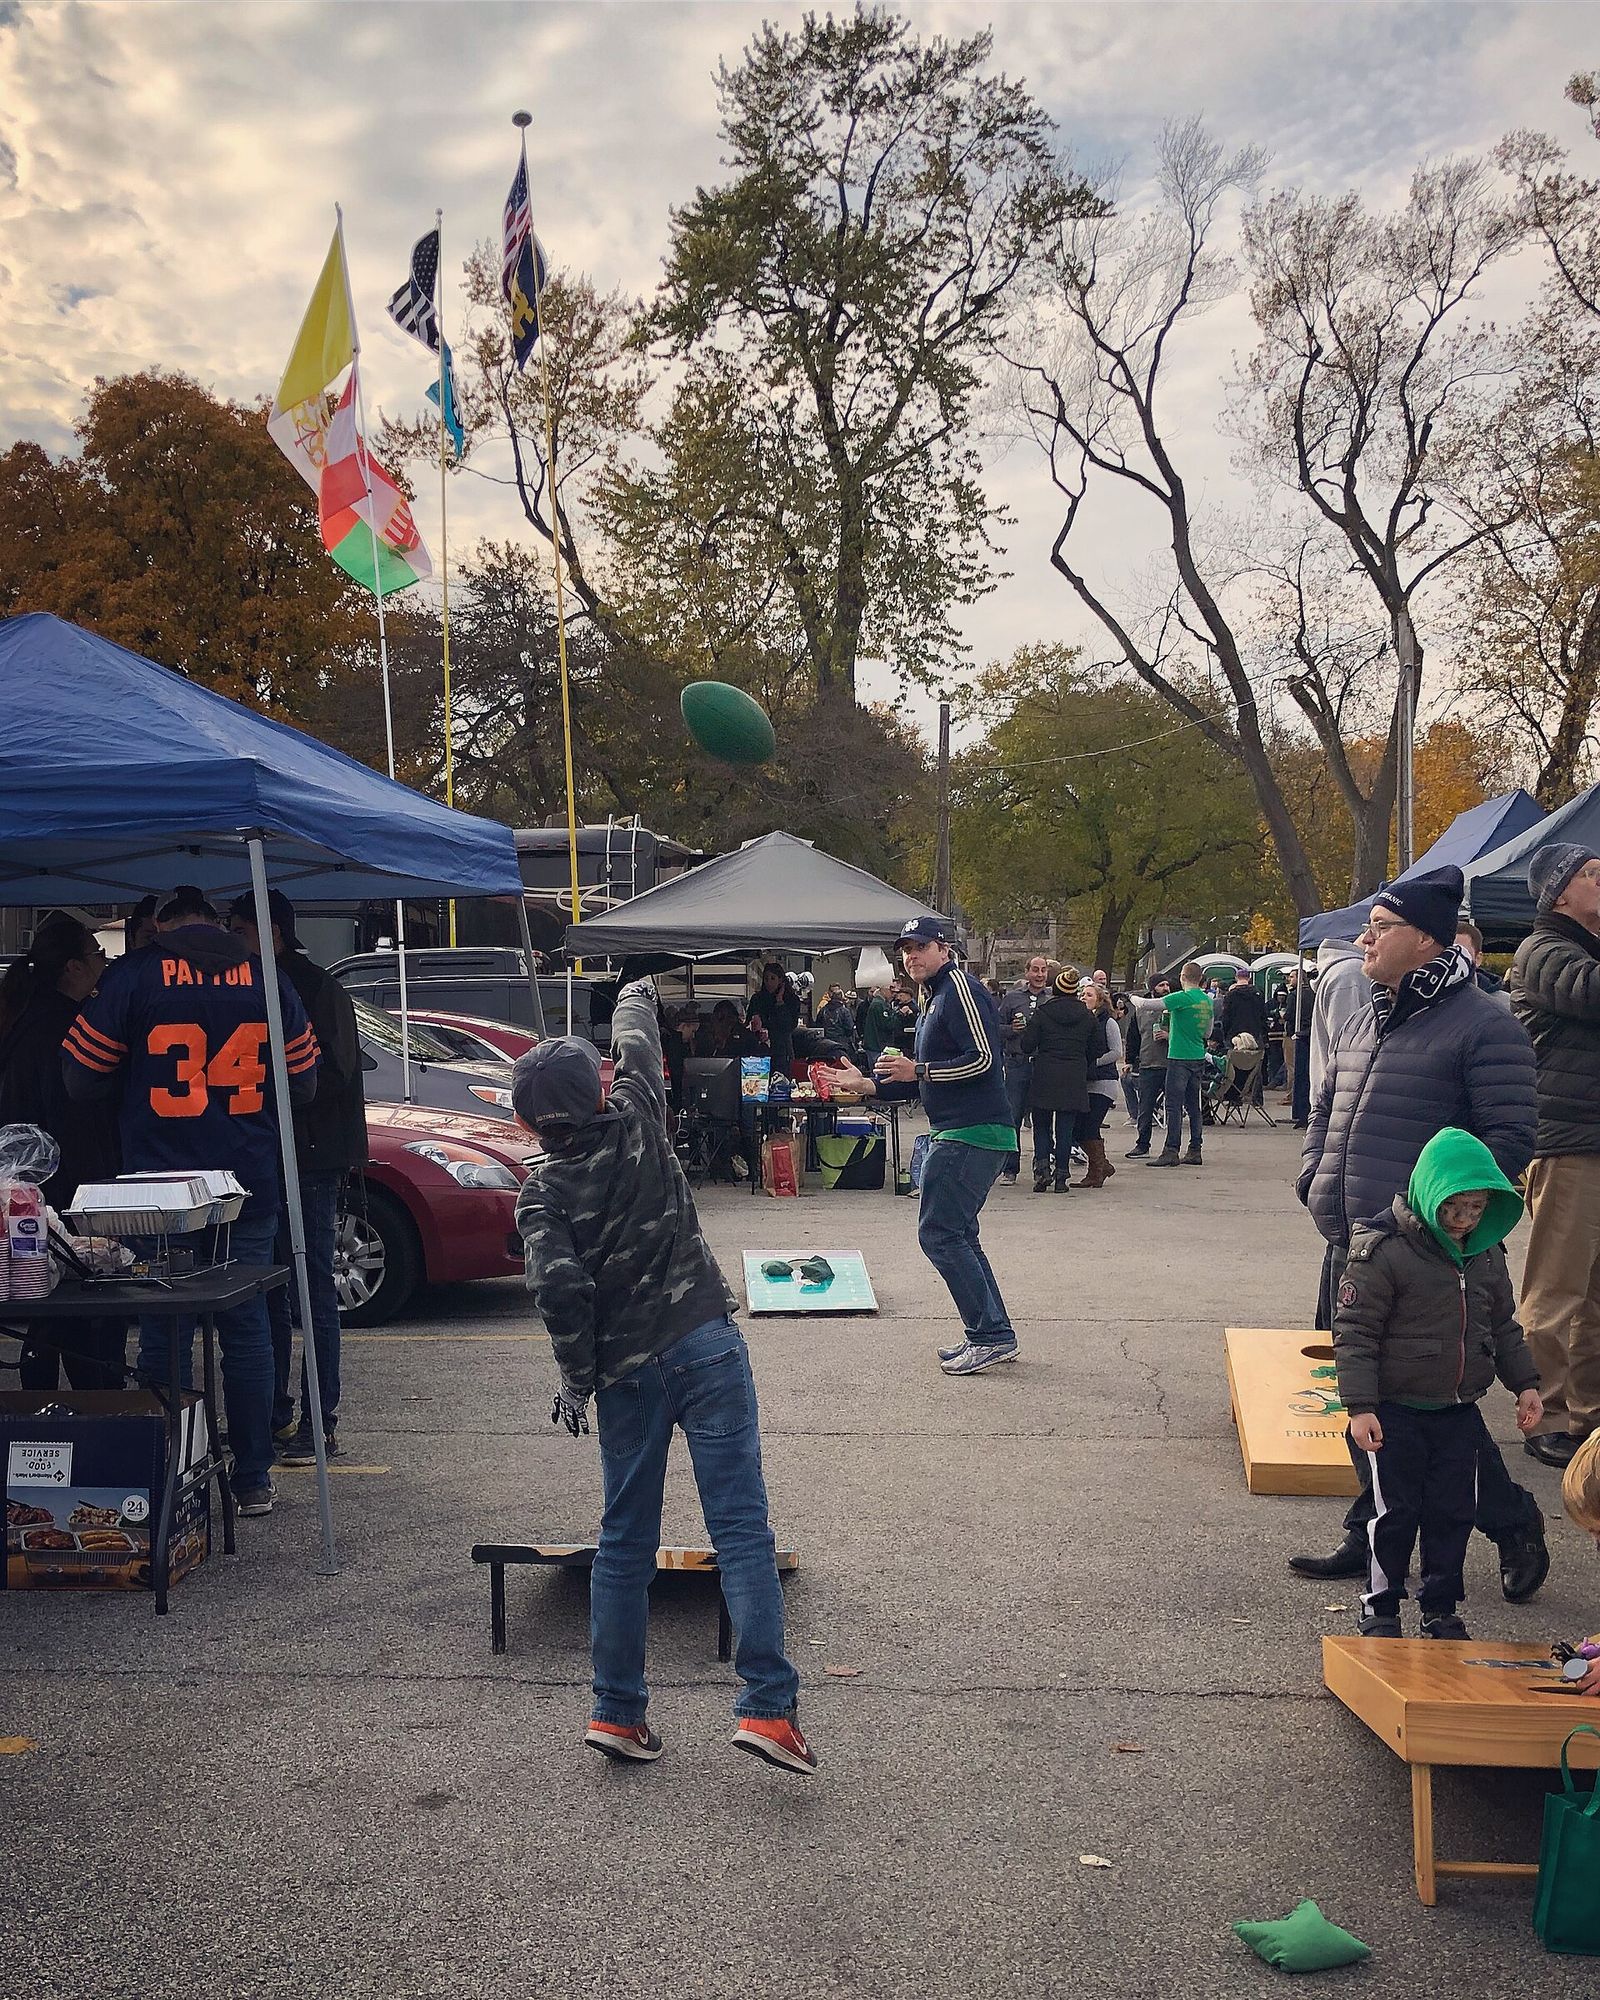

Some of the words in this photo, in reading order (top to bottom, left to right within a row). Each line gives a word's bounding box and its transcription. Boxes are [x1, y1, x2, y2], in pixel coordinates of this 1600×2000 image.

[147, 1022, 268, 1117] 34
[1285, 1430, 1345, 1438] FIGHTI
[21, 1449, 60, 1457] SERVICE
[28, 1461, 52, 1470] FOOD
[127, 1500, 145, 1513] 24
